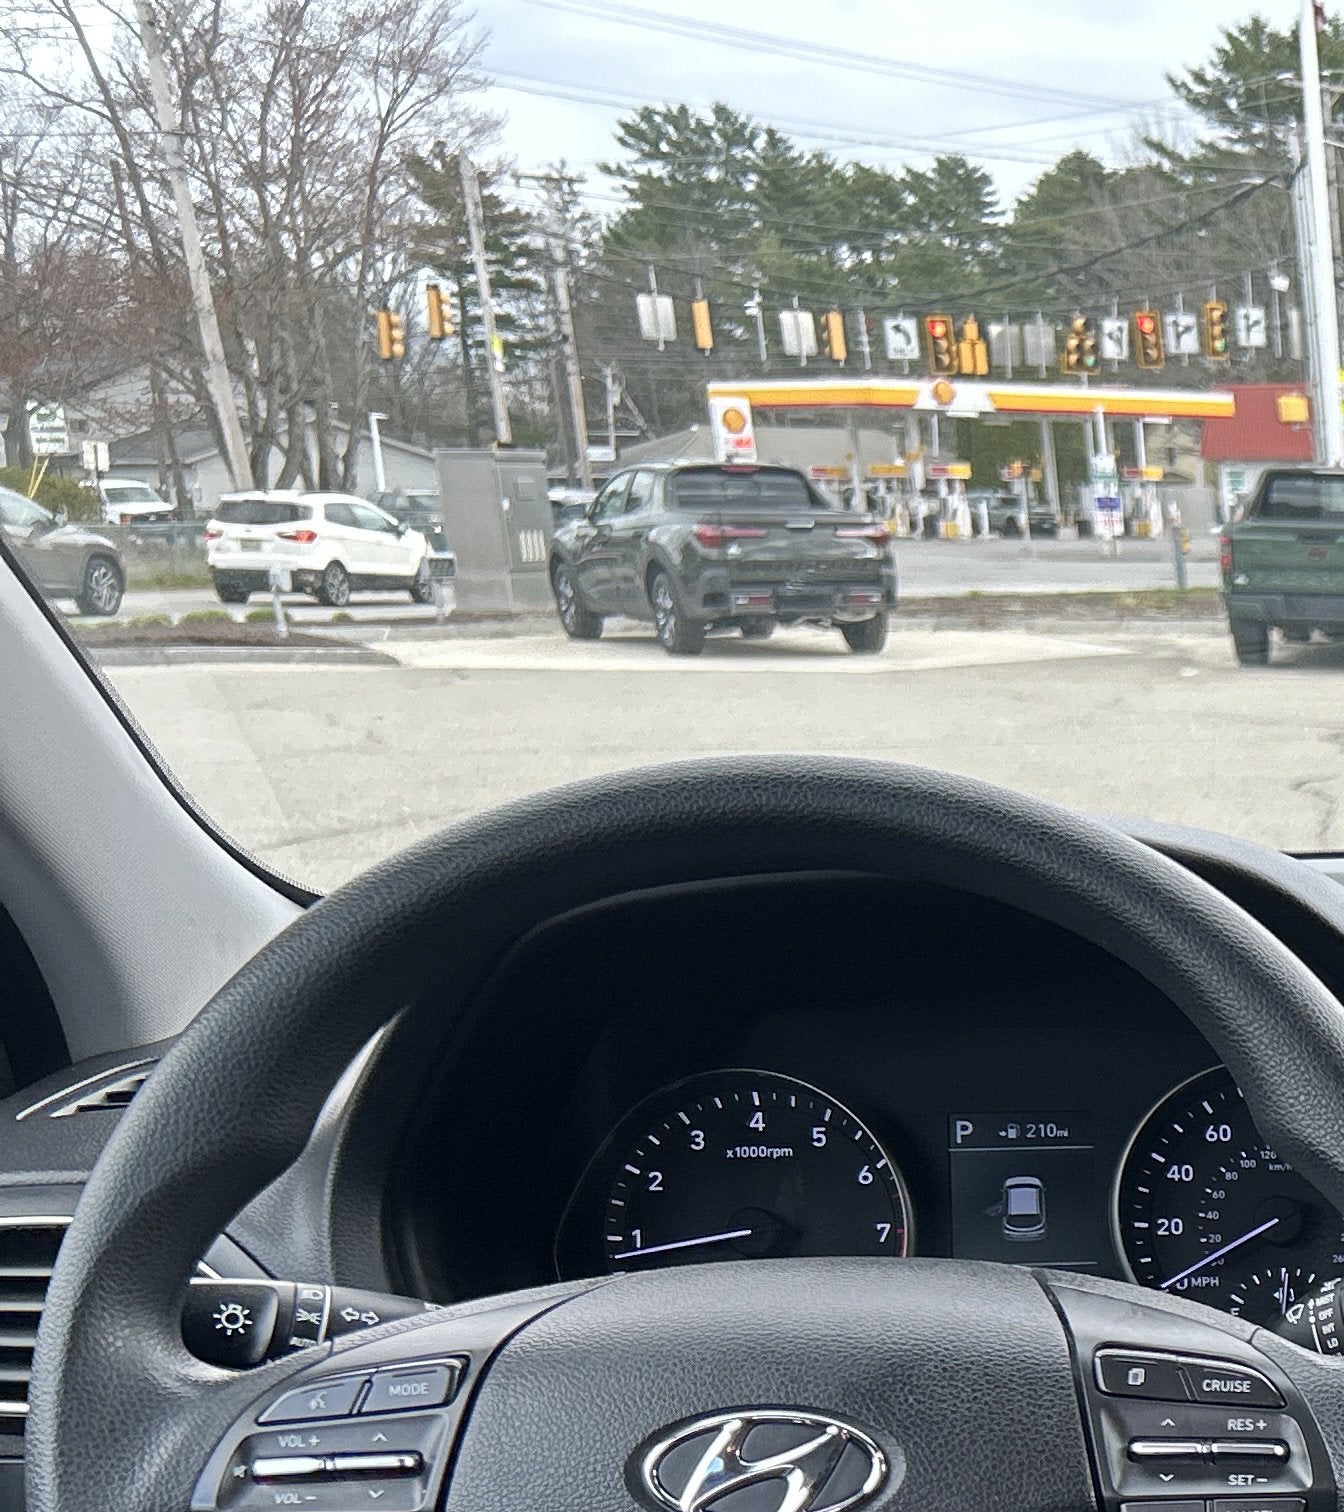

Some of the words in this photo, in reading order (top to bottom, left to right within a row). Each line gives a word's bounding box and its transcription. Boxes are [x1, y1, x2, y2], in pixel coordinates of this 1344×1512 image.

[749, 1111, 766, 1132] 4
[690, 1130, 705, 1150] 3
[812, 1126, 827, 1148] 5
[955, 1120, 974, 1144] P
[1206, 1124, 1232, 1143] 60
[726, 1145, 793, 1161] x1000rpm
[1240, 1158, 1257, 1169] 100
[1268, 1162, 1293, 1172] km/h
[858, 1165, 873, 1186] 6
[1166, 1164, 1194, 1183] 40
[1225, 1171, 1239, 1181] 80
[648, 1172, 664, 1192] 2
[1212, 1189, 1226, 1200] 60
[1206, 1210, 1220, 1220] 40
[876, 1222, 891, 1243] 7
[1157, 1217, 1184, 1236] 20
[631, 1229, 641, 1249] 1
[1208, 1233, 1222, 1243] 20
[1191, 1276, 1220, 1288] MPH
[388, 1382, 430, 1397] MODE
[1202, 1379, 1252, 1393] CRUISE
[277, 1435, 306, 1448] VOL
[274, 1492, 302, 1505] VOL
